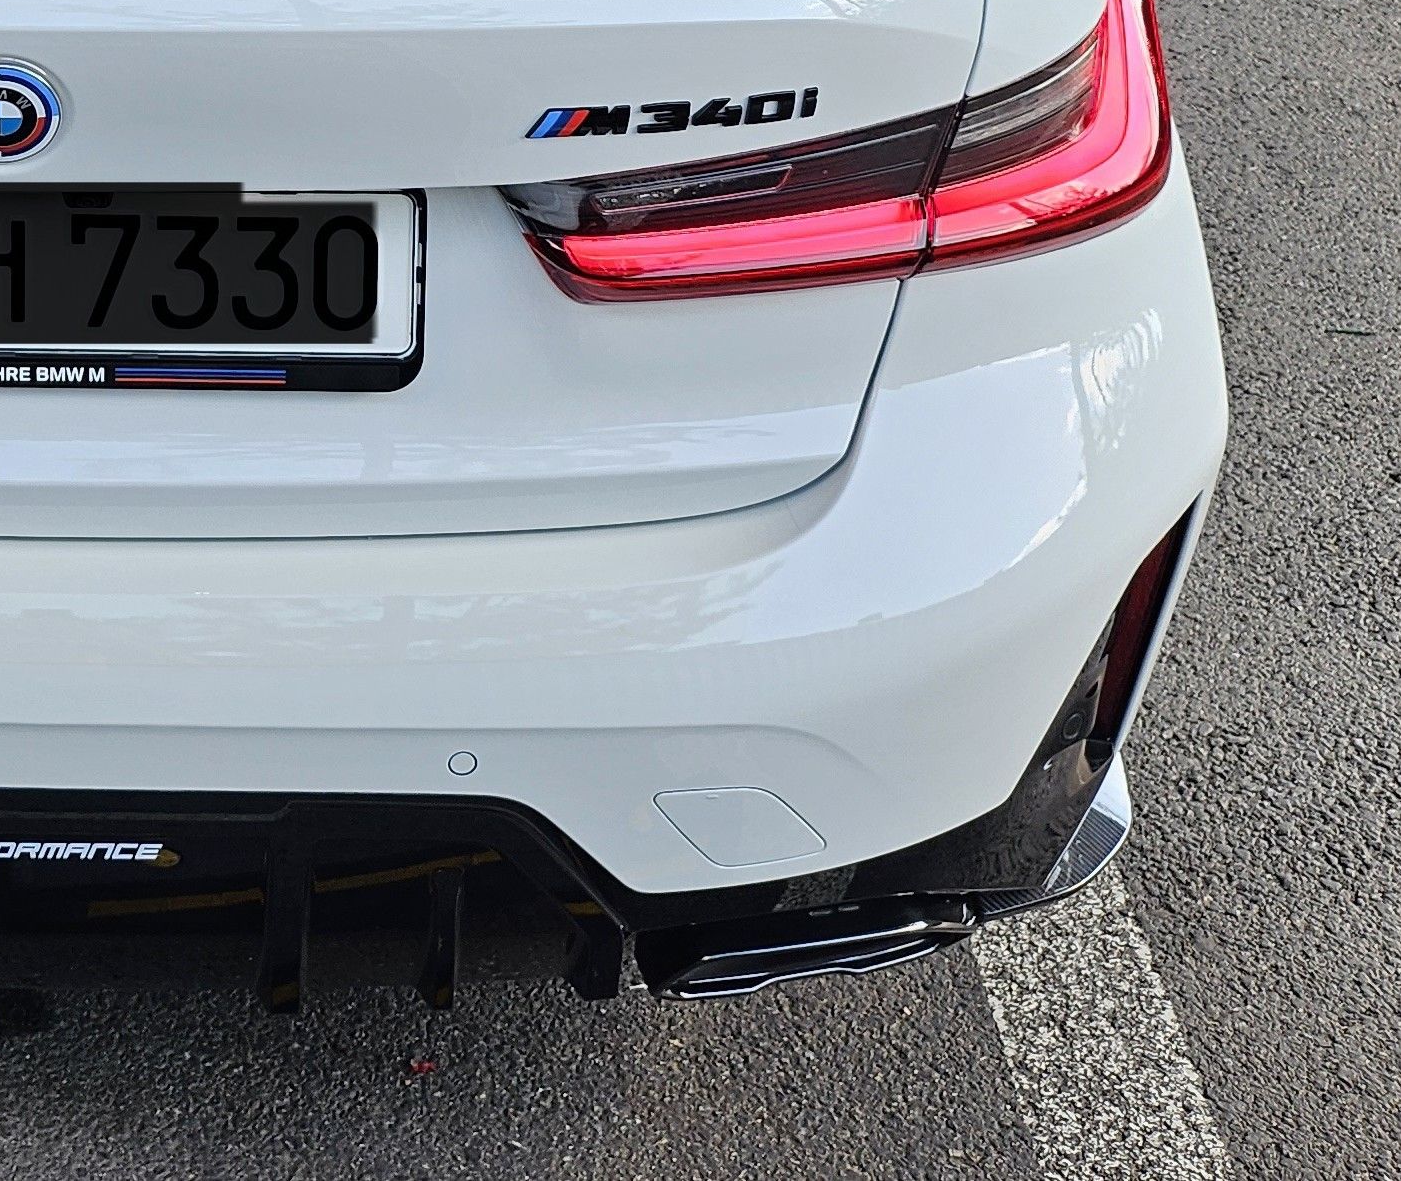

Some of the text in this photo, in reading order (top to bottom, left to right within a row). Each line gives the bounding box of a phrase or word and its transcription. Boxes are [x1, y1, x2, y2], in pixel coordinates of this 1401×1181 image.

[70, 214, 379, 332] 7330
[35, 366, 85, 382] BMW
[88, 367, 105, 382] M
